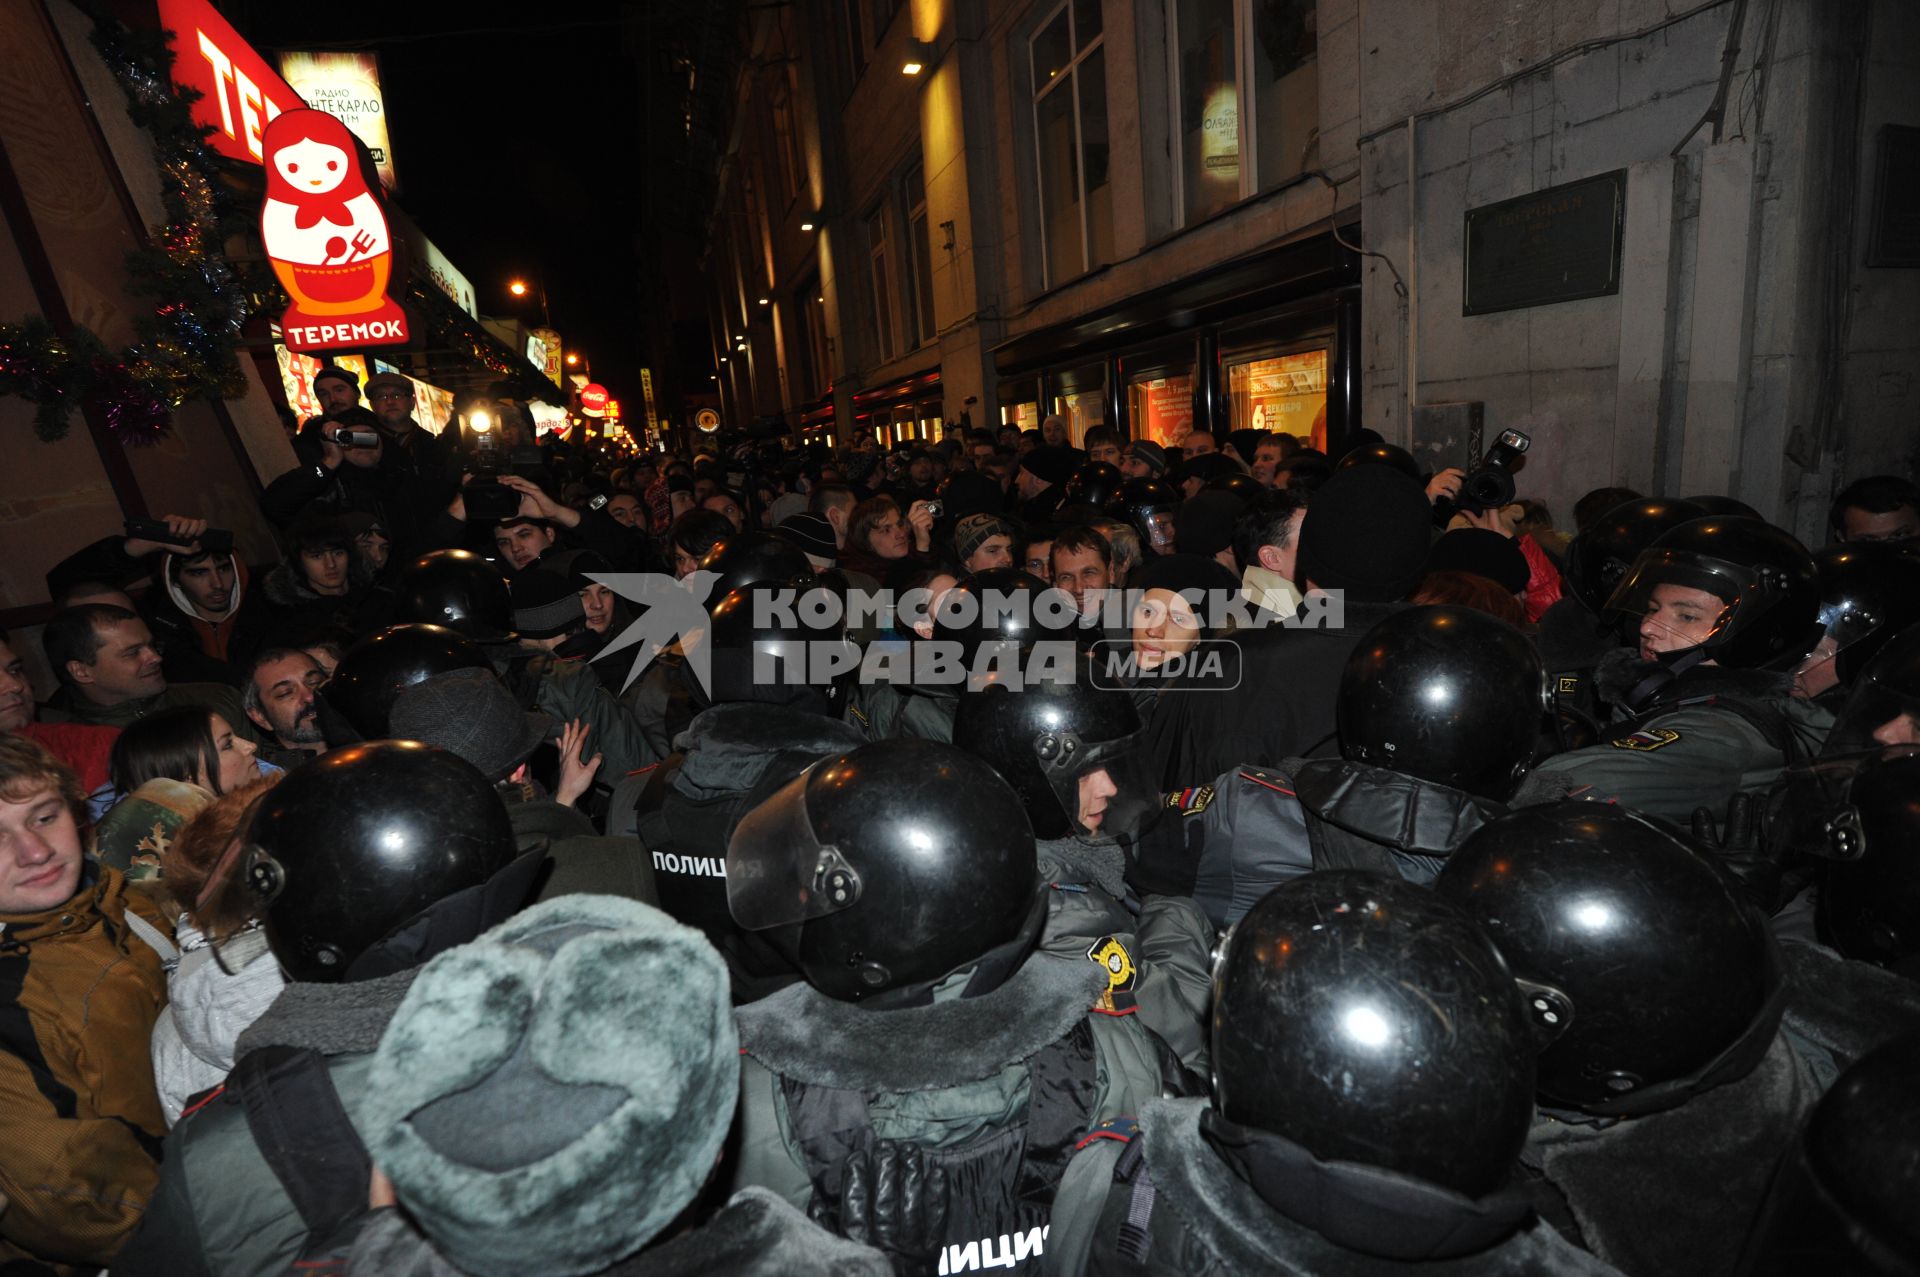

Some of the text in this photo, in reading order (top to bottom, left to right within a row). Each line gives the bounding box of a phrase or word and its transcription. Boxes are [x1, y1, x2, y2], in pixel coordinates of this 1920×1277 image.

[314, 88, 350, 98] РАДИО
[337, 99, 380, 113] КАРЛО
[288, 319, 404, 345] ТЕРЕМОК
[1252, 404, 1266, 430] 6
